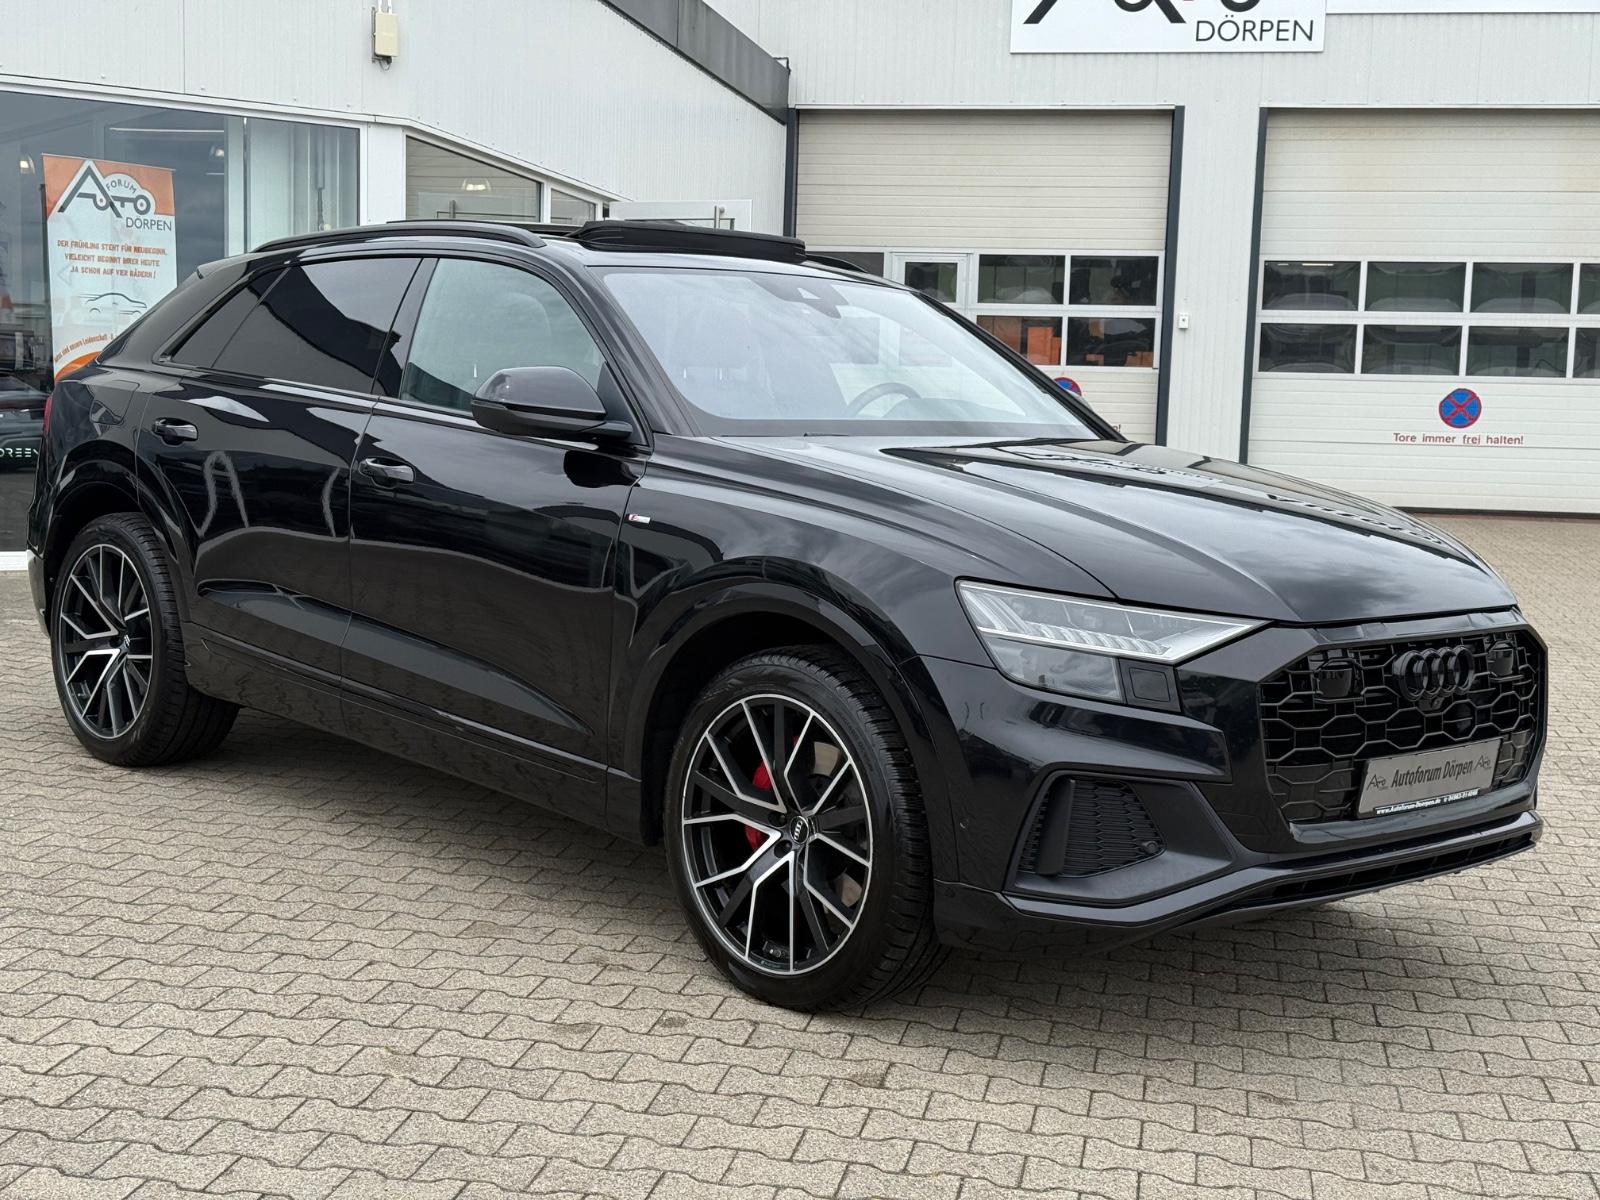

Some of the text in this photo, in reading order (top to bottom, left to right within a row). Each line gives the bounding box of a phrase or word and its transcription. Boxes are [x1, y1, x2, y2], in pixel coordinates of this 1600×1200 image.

[1195, 14, 1314, 42] DÖRPEN
[105, 179, 137, 194] FORUM
[125, 216, 172, 231] DÖRPEN
[57, 239, 69, 247] DER
[70, 239, 100, 250] FRÜHLING
[101, 243, 120, 252] STEHT
[121, 243, 132, 253] FÜR
[140, 258, 161, 267] HEUTE
[70, 265, 79, 273] JA
[81, 266, 101, 275] SCHON
[102, 268, 115, 276] AUF
[1393, 432, 1524, 446] Tore immer frei halten!
[1390, 759, 1473, 788] Autoforum Dörpen
